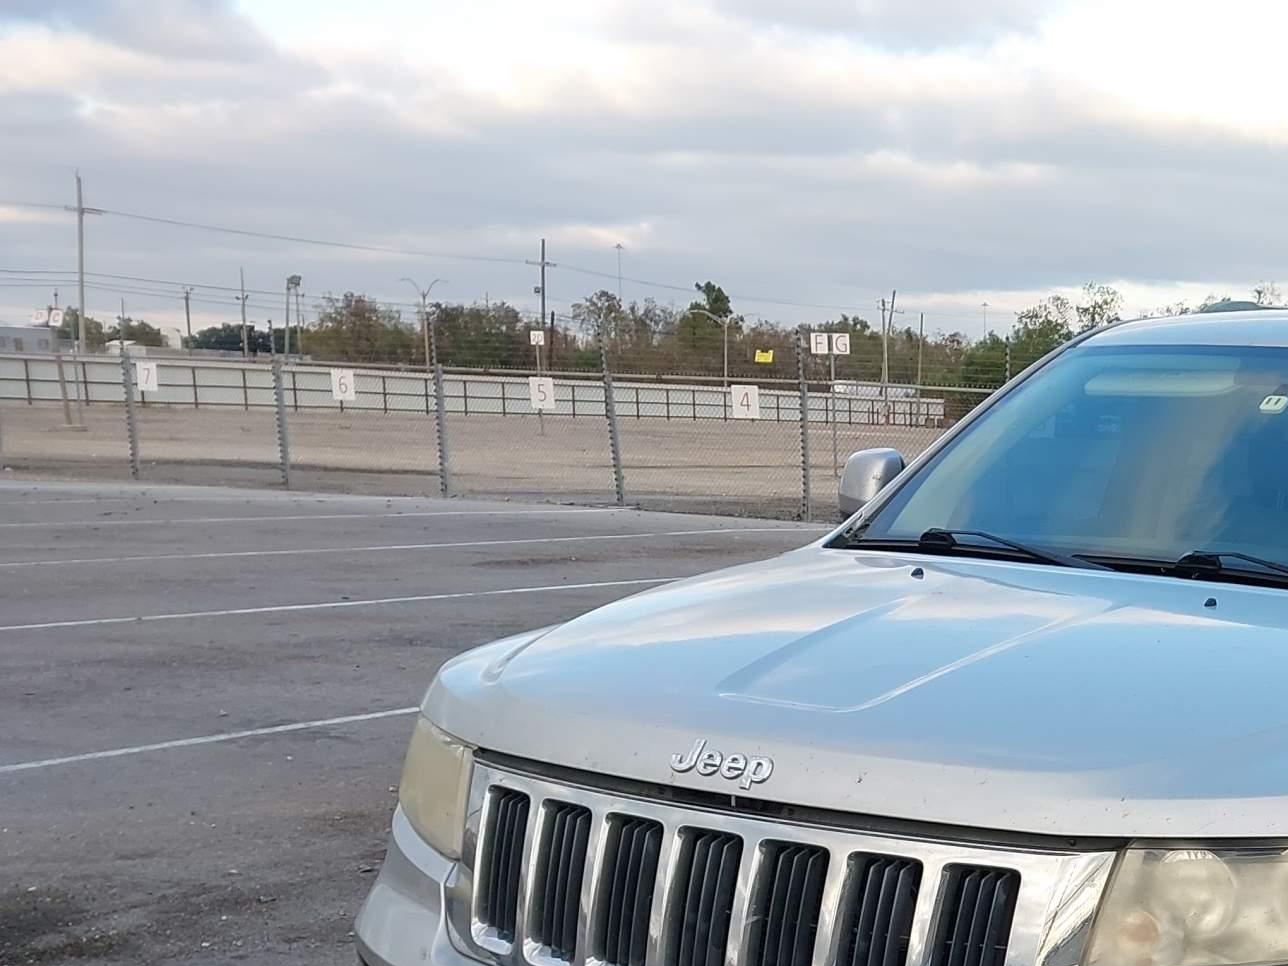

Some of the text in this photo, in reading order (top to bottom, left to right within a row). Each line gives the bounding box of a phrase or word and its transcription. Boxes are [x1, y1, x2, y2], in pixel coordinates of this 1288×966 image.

[814, 334, 823, 352] F
[835, 334, 848, 353] G
[142, 367, 151, 385] 7
[338, 375, 348, 394] 6
[537, 383, 548, 402] 5
[739, 391, 752, 413] 4
[671, 738, 774, 790] Jeep
